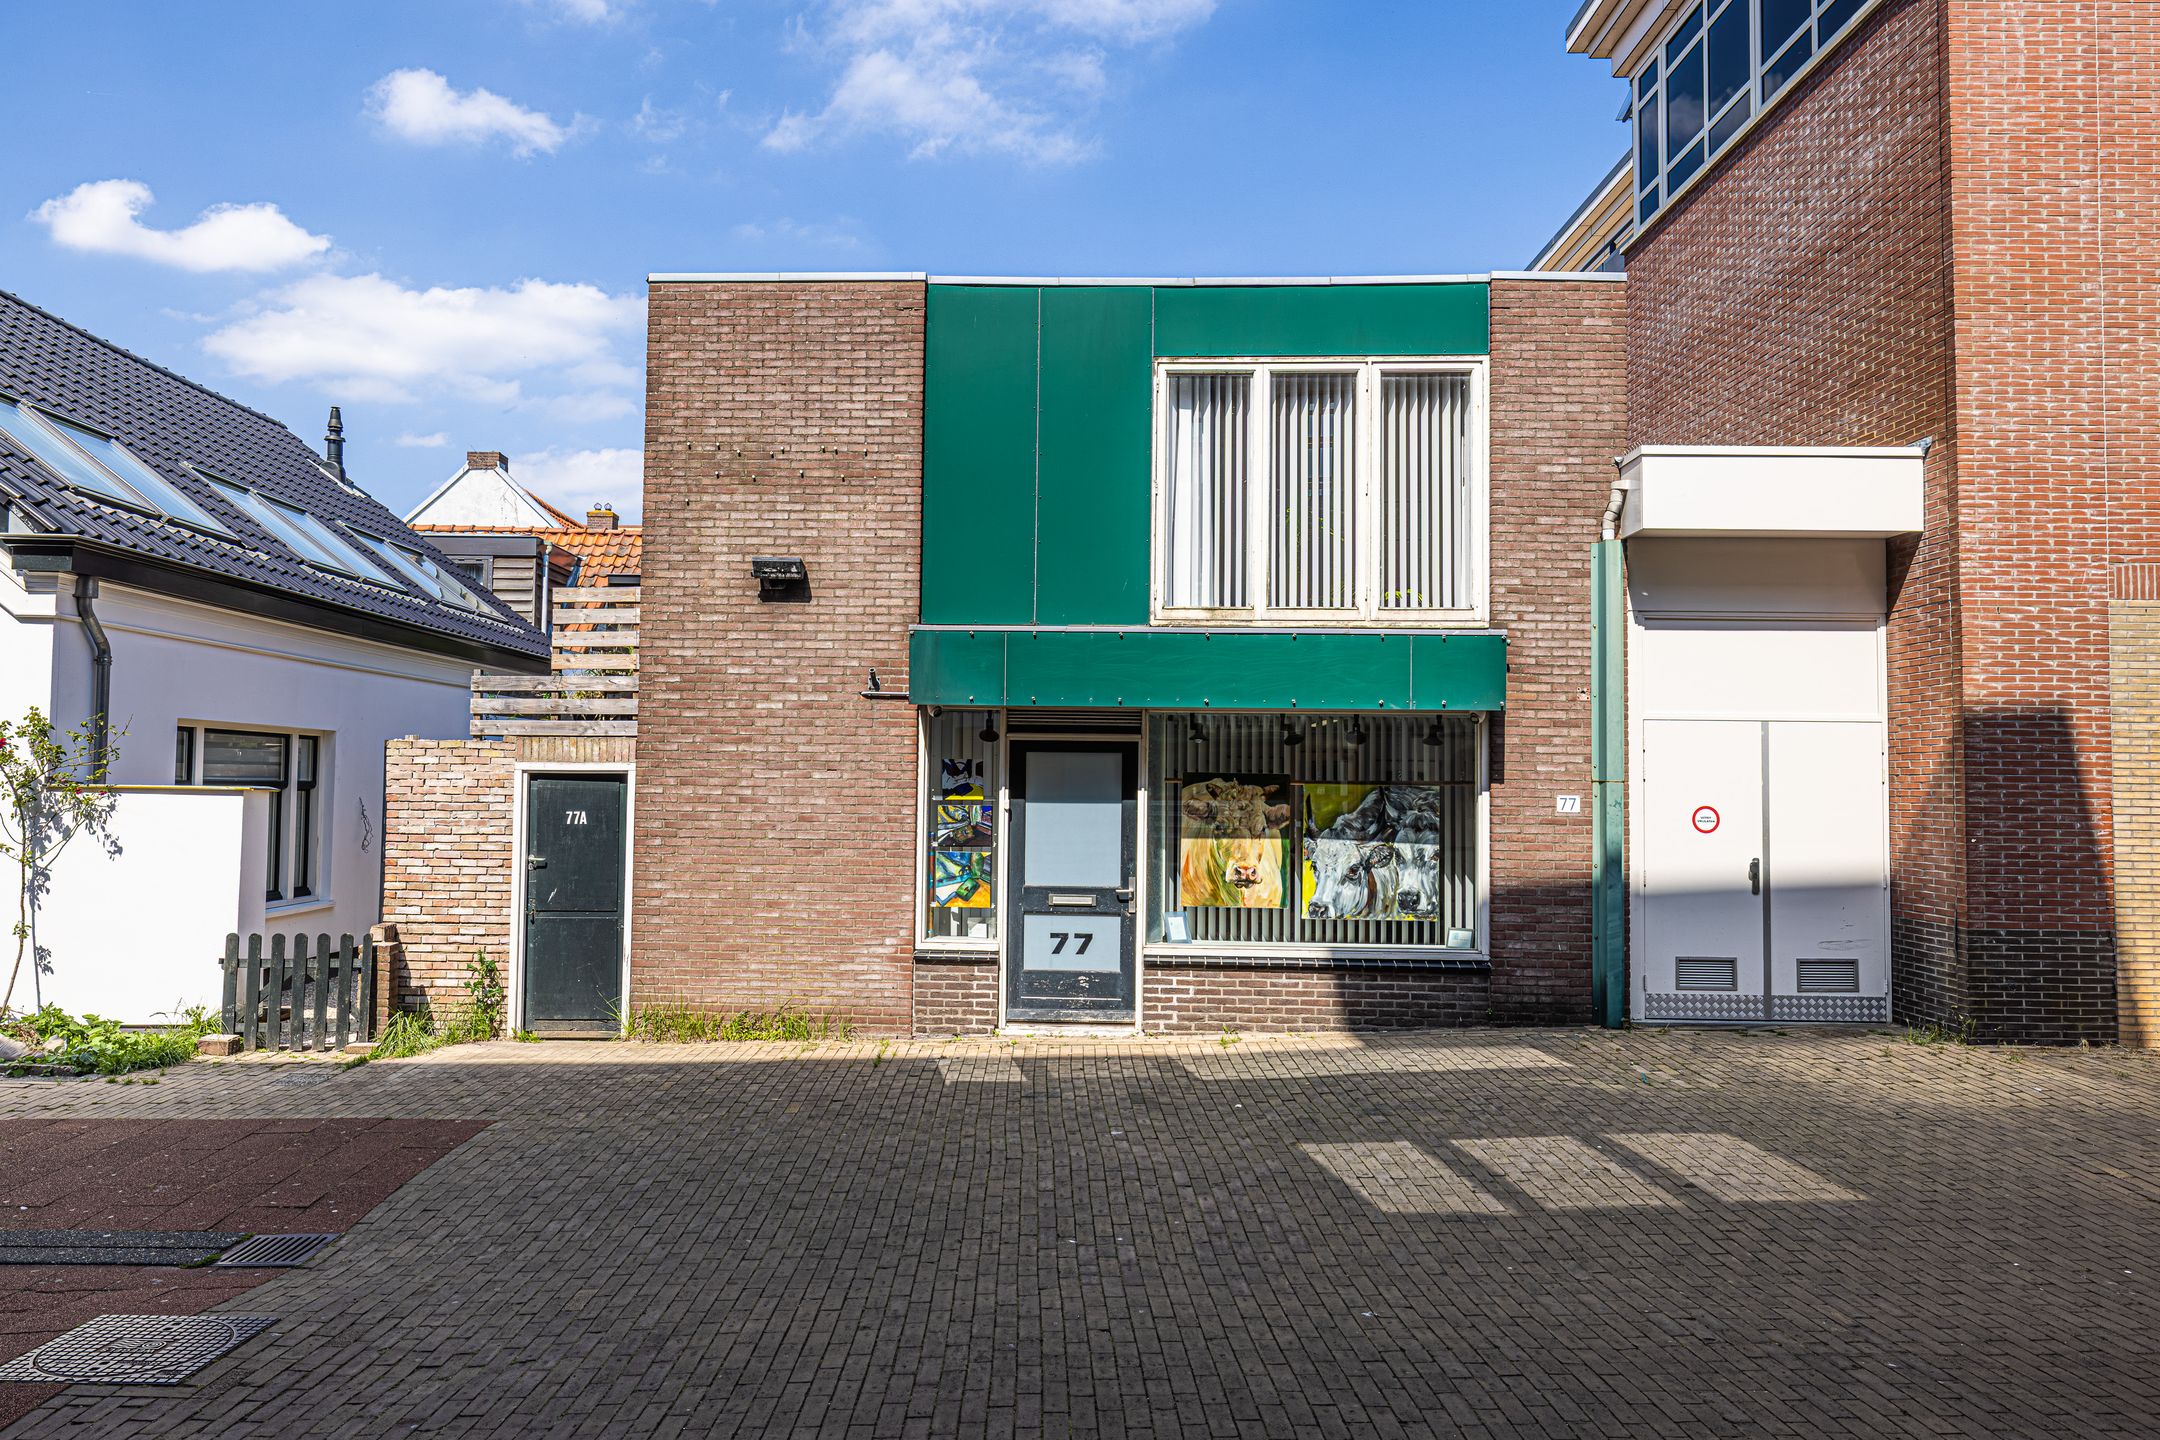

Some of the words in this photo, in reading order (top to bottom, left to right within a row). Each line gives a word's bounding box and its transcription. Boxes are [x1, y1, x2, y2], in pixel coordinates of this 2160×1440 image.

[1559, 797, 1577, 811] 77
[565, 810, 588, 825] 77A
[1049, 932, 1094, 955] 77
